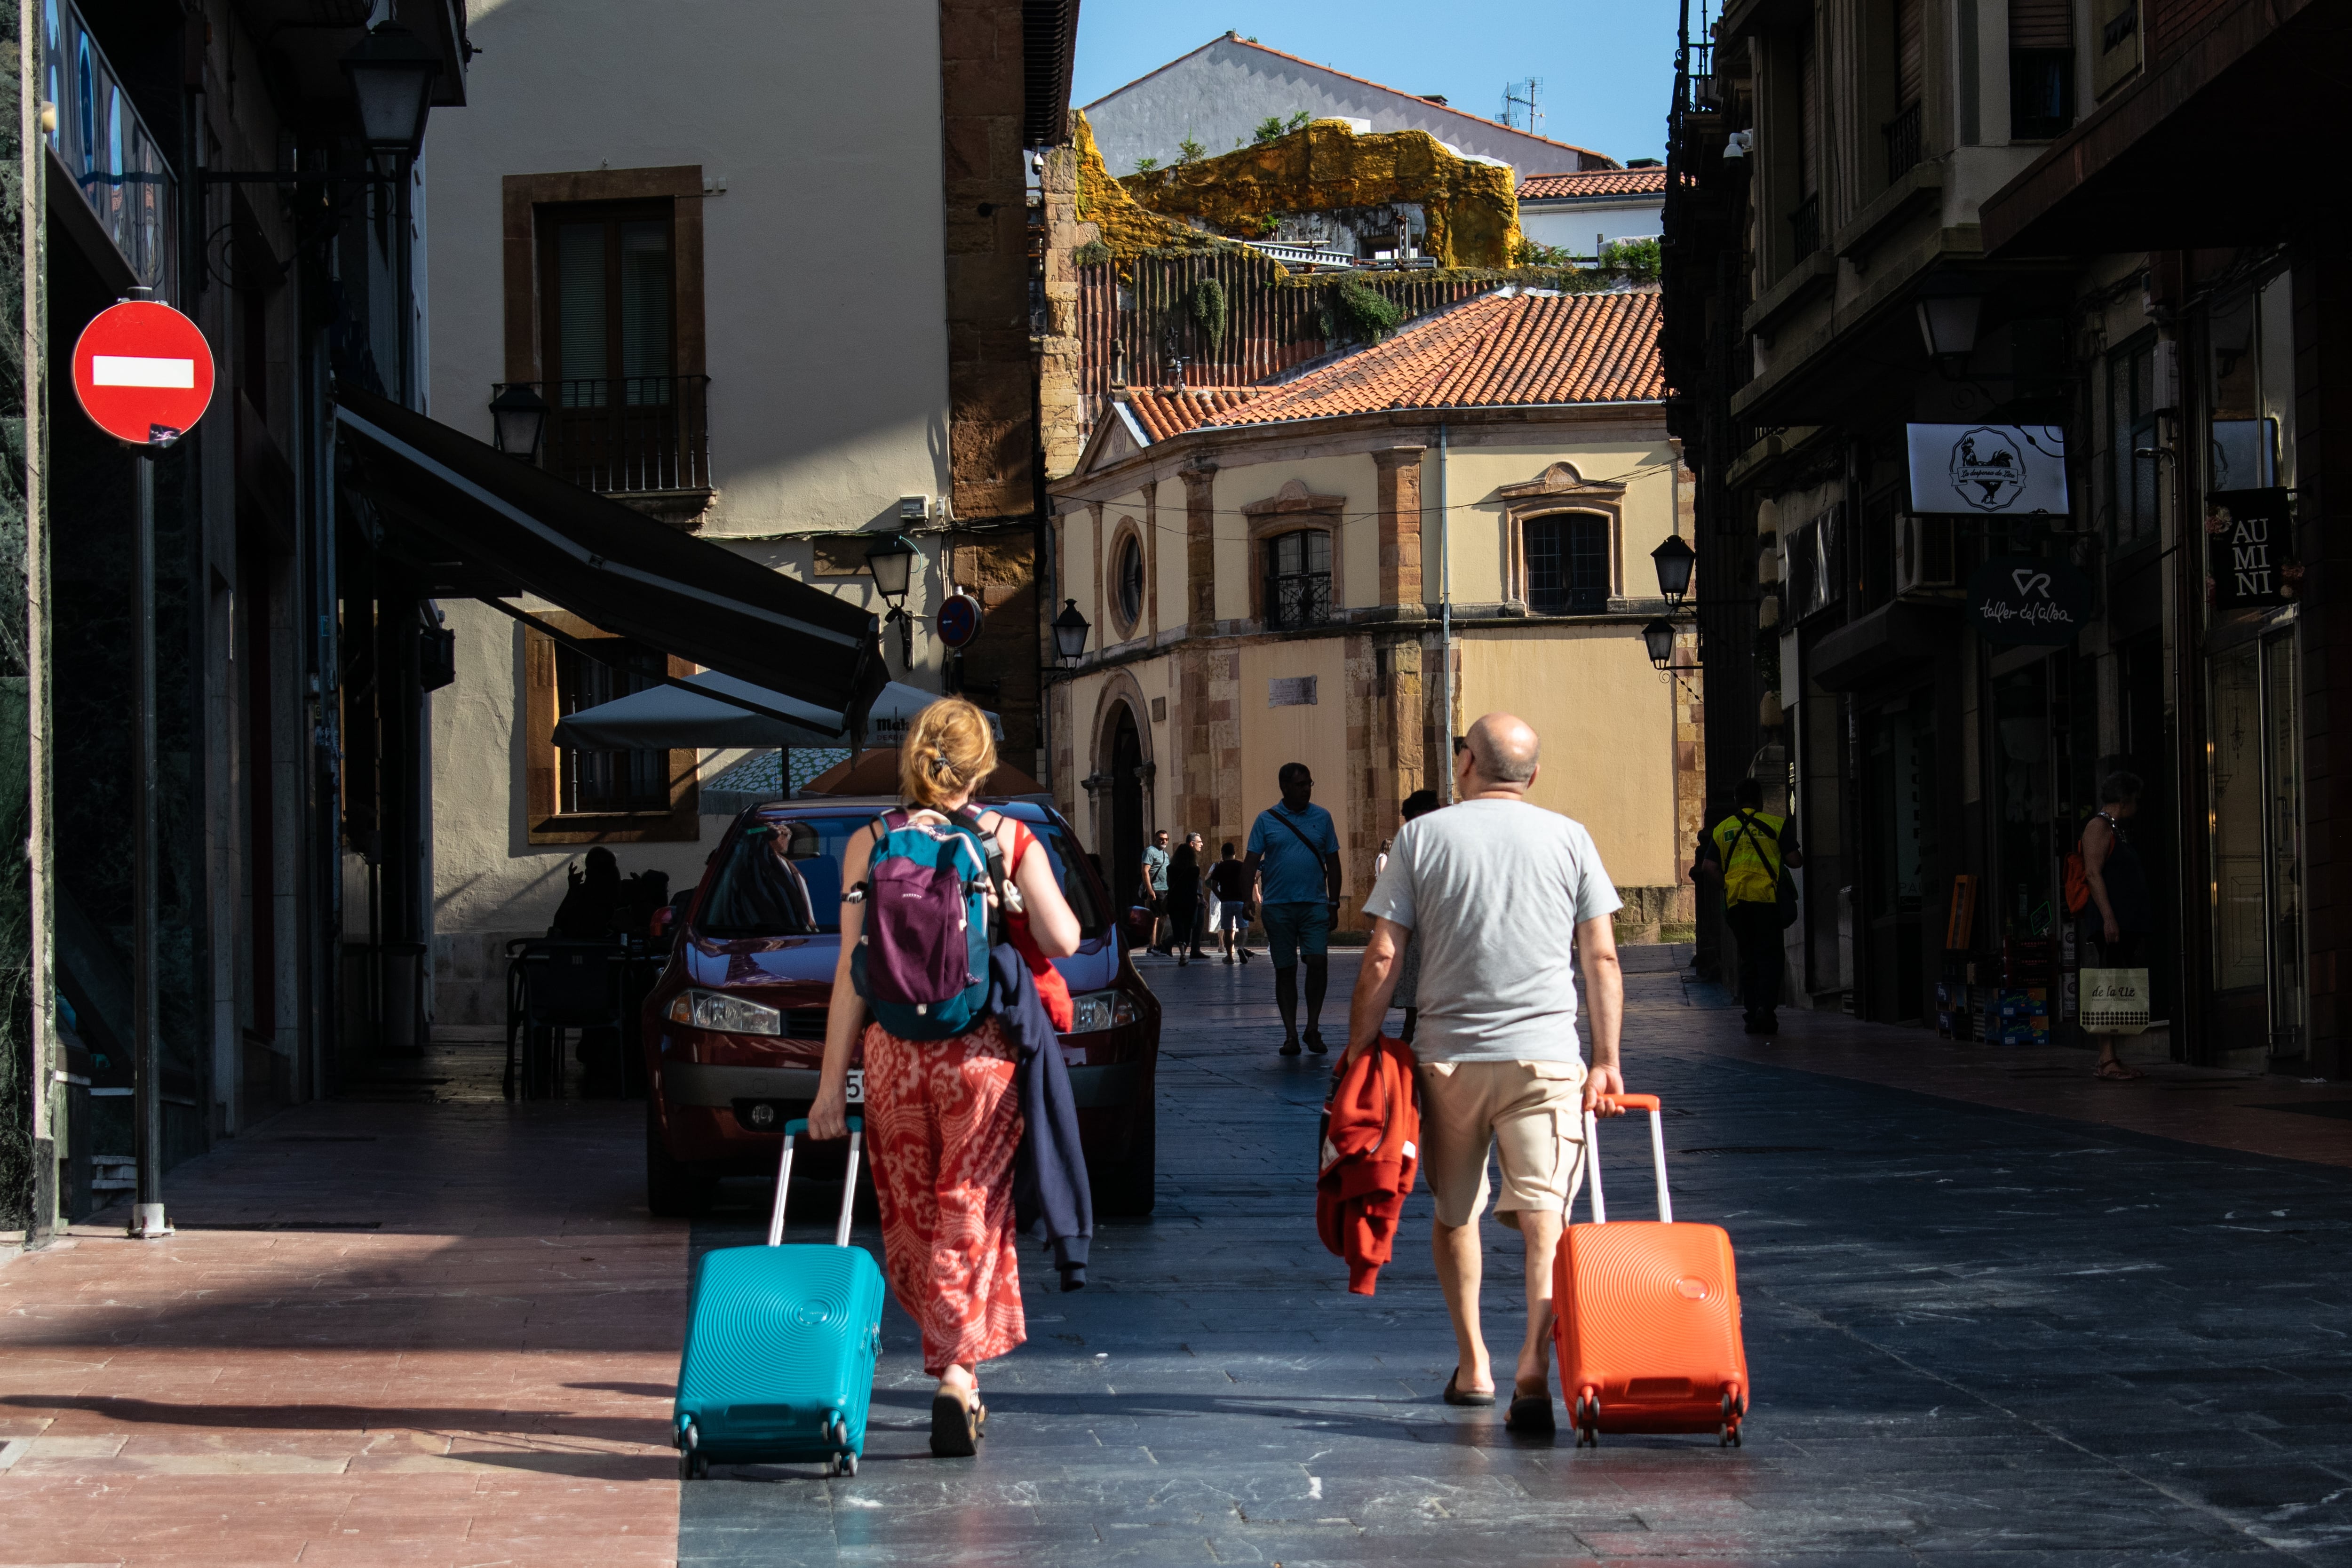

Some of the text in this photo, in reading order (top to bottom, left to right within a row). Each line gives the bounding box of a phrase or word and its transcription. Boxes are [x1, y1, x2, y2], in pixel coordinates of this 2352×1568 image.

[1961, 470, 1970, 478] La
[1970, 469, 1994, 478] despensa
[2002, 470, 2016, 478] Lita
[2232, 518, 2269, 544] AU
[2232, 544, 2271, 570] MI
[2234, 570, 2273, 597] NI
[1979, 598, 2018, 623] taller
[876, 718, 910, 731] Mah
[2092, 985, 2104, 997] de
[2106, 985, 2116, 997] la
[847, 1075, 865, 1098] 5
